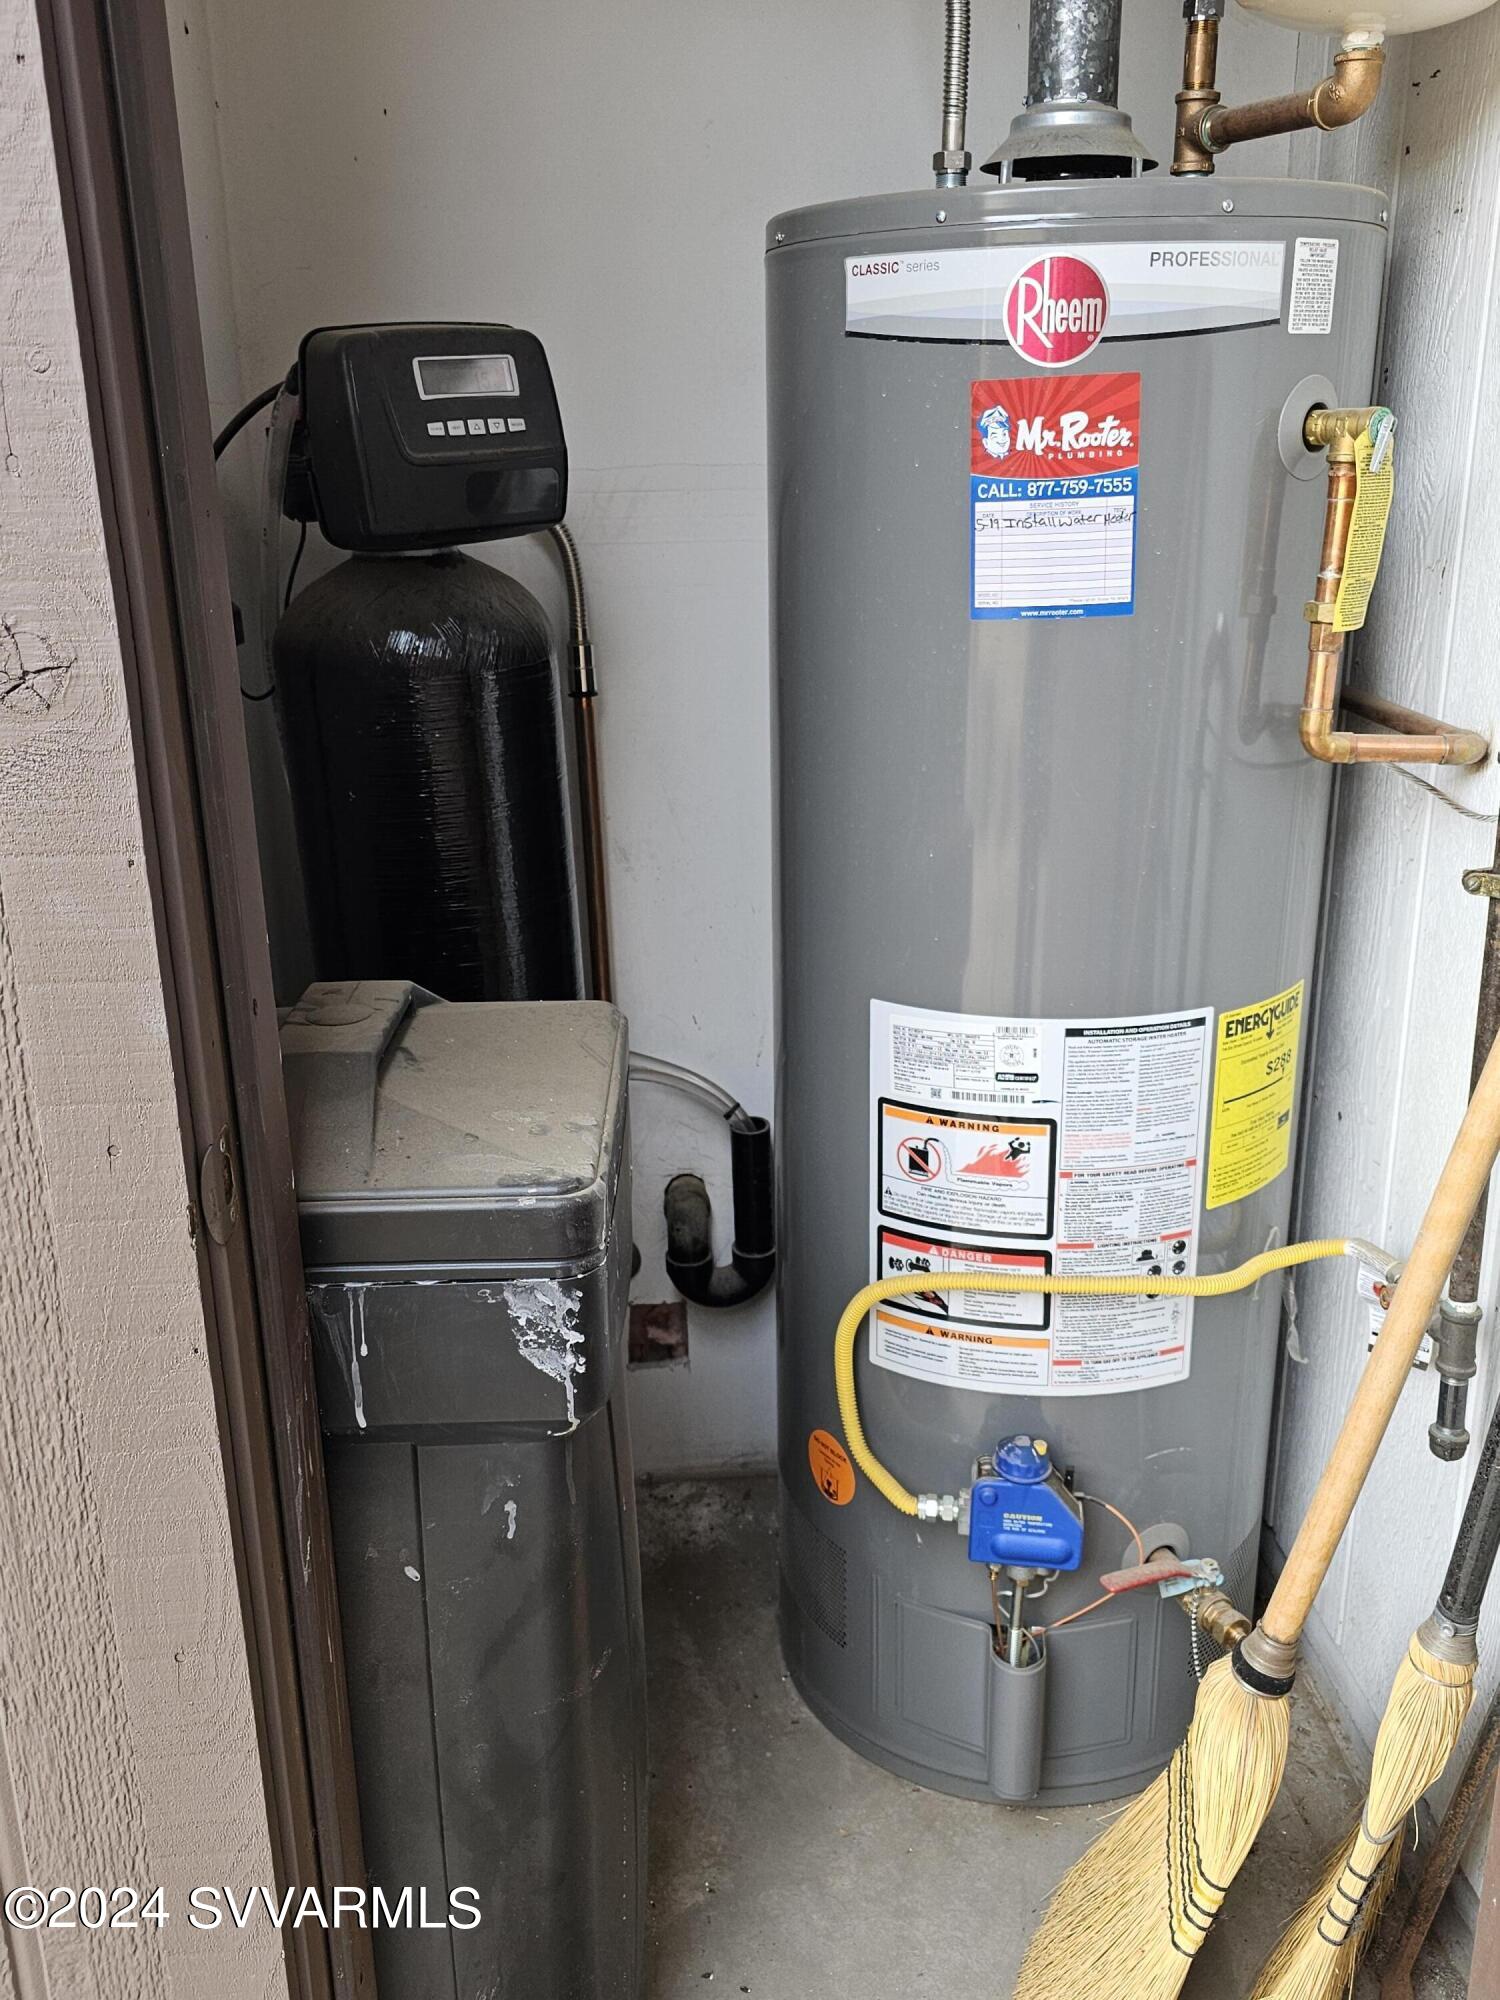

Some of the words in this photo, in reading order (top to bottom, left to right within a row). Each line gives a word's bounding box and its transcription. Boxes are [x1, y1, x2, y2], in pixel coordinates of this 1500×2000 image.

[905, 259, 940, 273] series
[1150, 250, 1280, 267] PROFESSIONAL
[1016, 258, 1103, 349] Rheem
[1016, 415, 1061, 456] Mr.
[1048, 449, 1123, 460] PLUMBING
[977, 482, 1022, 499] CALL:
[1027, 477, 1133, 497] 877-759-7555
[1002, 513, 1057, 529] Install
[1020, 609, 1084, 617] www.mrrooter.com
[1225, 991, 1300, 1040] ENERGYGUIDE
[1083, 1028, 1125, 1036] INSTALLATION
[1139, 1024, 1170, 1034] OPERATION
[1170, 1020, 1191, 1030] DETAILS
[939, 1118, 1000, 1132] WARNING
[957, 1177, 990, 1186] Flammable
[992, 1180, 1013, 1188] Vapors
[941, 1247, 993, 1263] DANGER
[940, 1329, 993, 1345] WARNING
[1002, 1512, 1043, 1522] CAUTION
